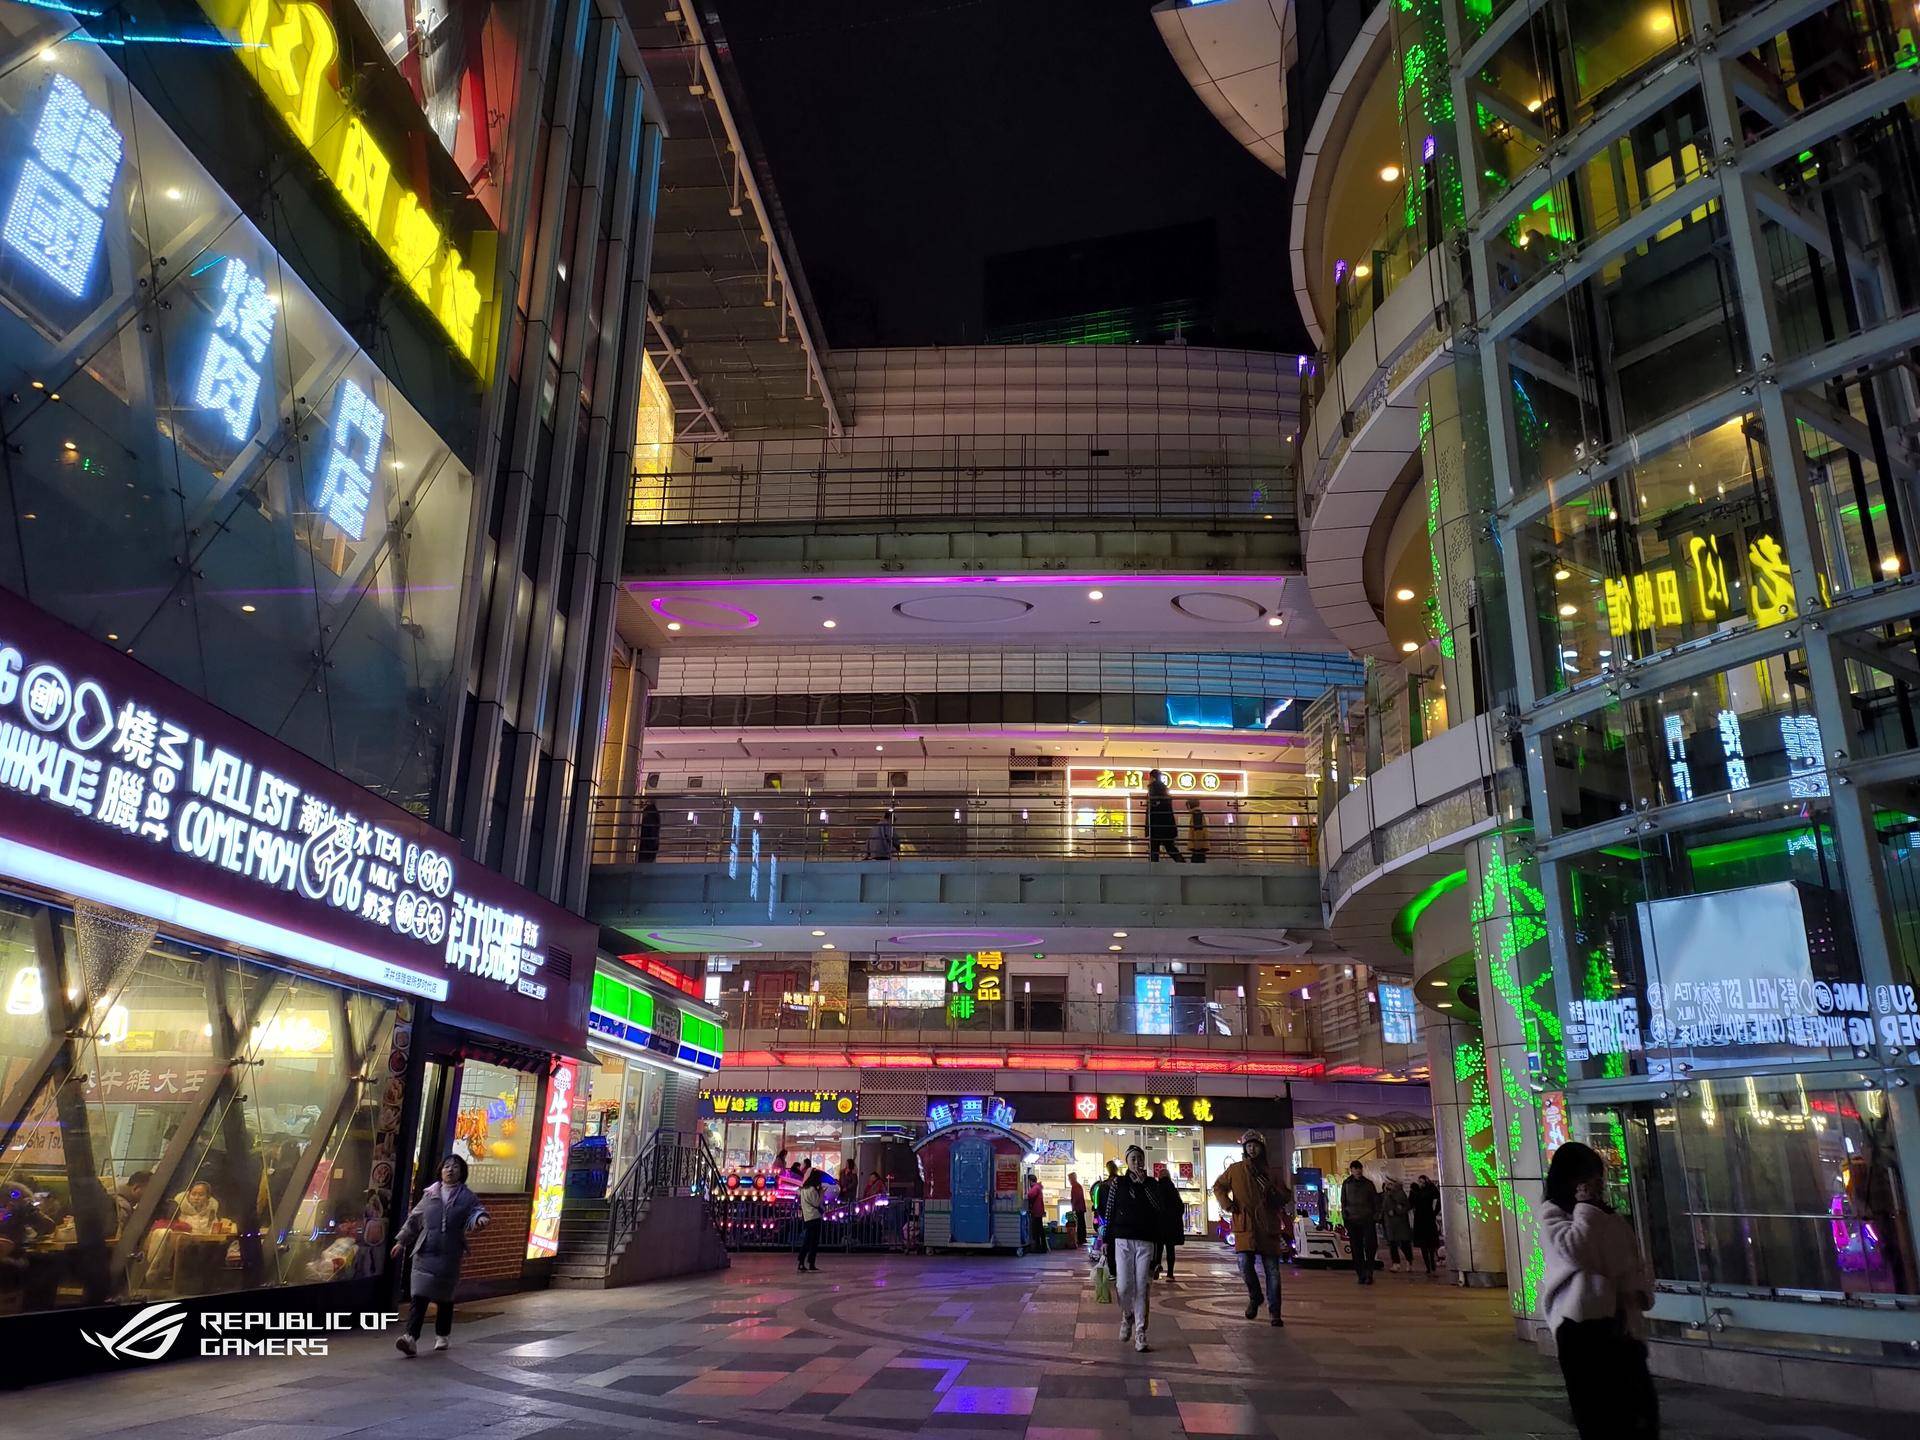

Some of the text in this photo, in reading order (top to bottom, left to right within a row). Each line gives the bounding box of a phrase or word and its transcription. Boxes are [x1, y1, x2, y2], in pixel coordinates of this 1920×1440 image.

[141, 722, 189, 841] Meat
[192, 739, 300, 831] WELL EST
[179, 801, 301, 890] COME 1904
[369, 863, 398, 893] MILK
[374, 827, 402, 866] TEA
[362, 890, 394, 926] 奶茶
[947, 954, 976, 1019] 牛排
